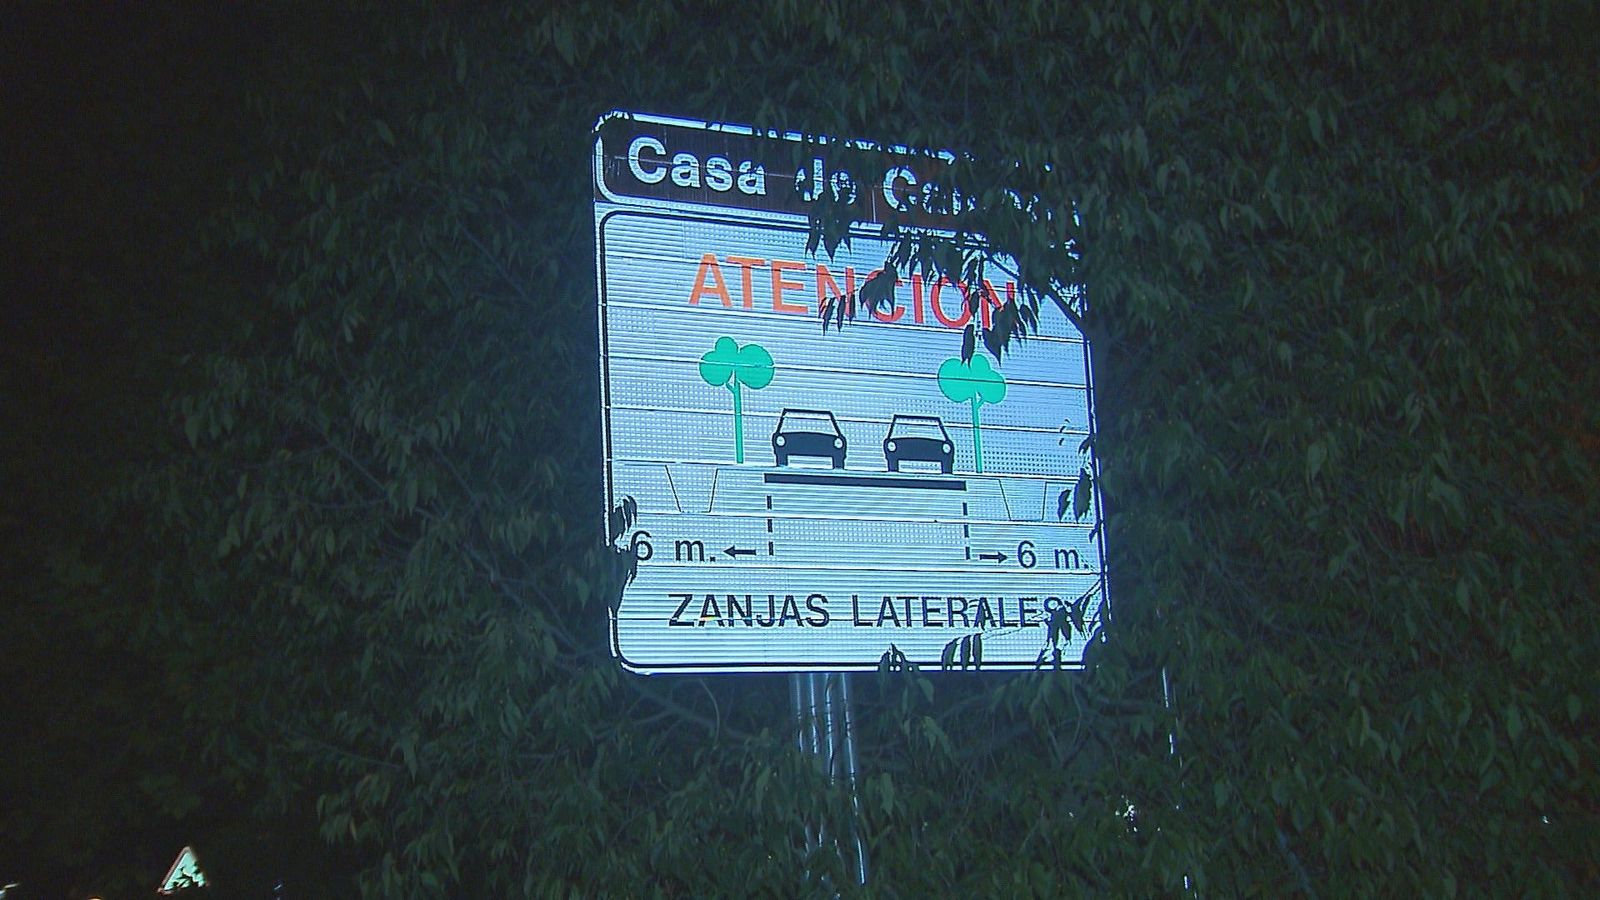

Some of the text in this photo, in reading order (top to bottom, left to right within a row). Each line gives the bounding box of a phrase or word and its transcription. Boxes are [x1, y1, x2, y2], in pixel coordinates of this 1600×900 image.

[627, 136, 767, 196] Casa
[630, 530, 717, 563] 6 m.
[1016, 540, 1091, 571] 6 m.
[667, 593, 831, 628] ZANJAS
